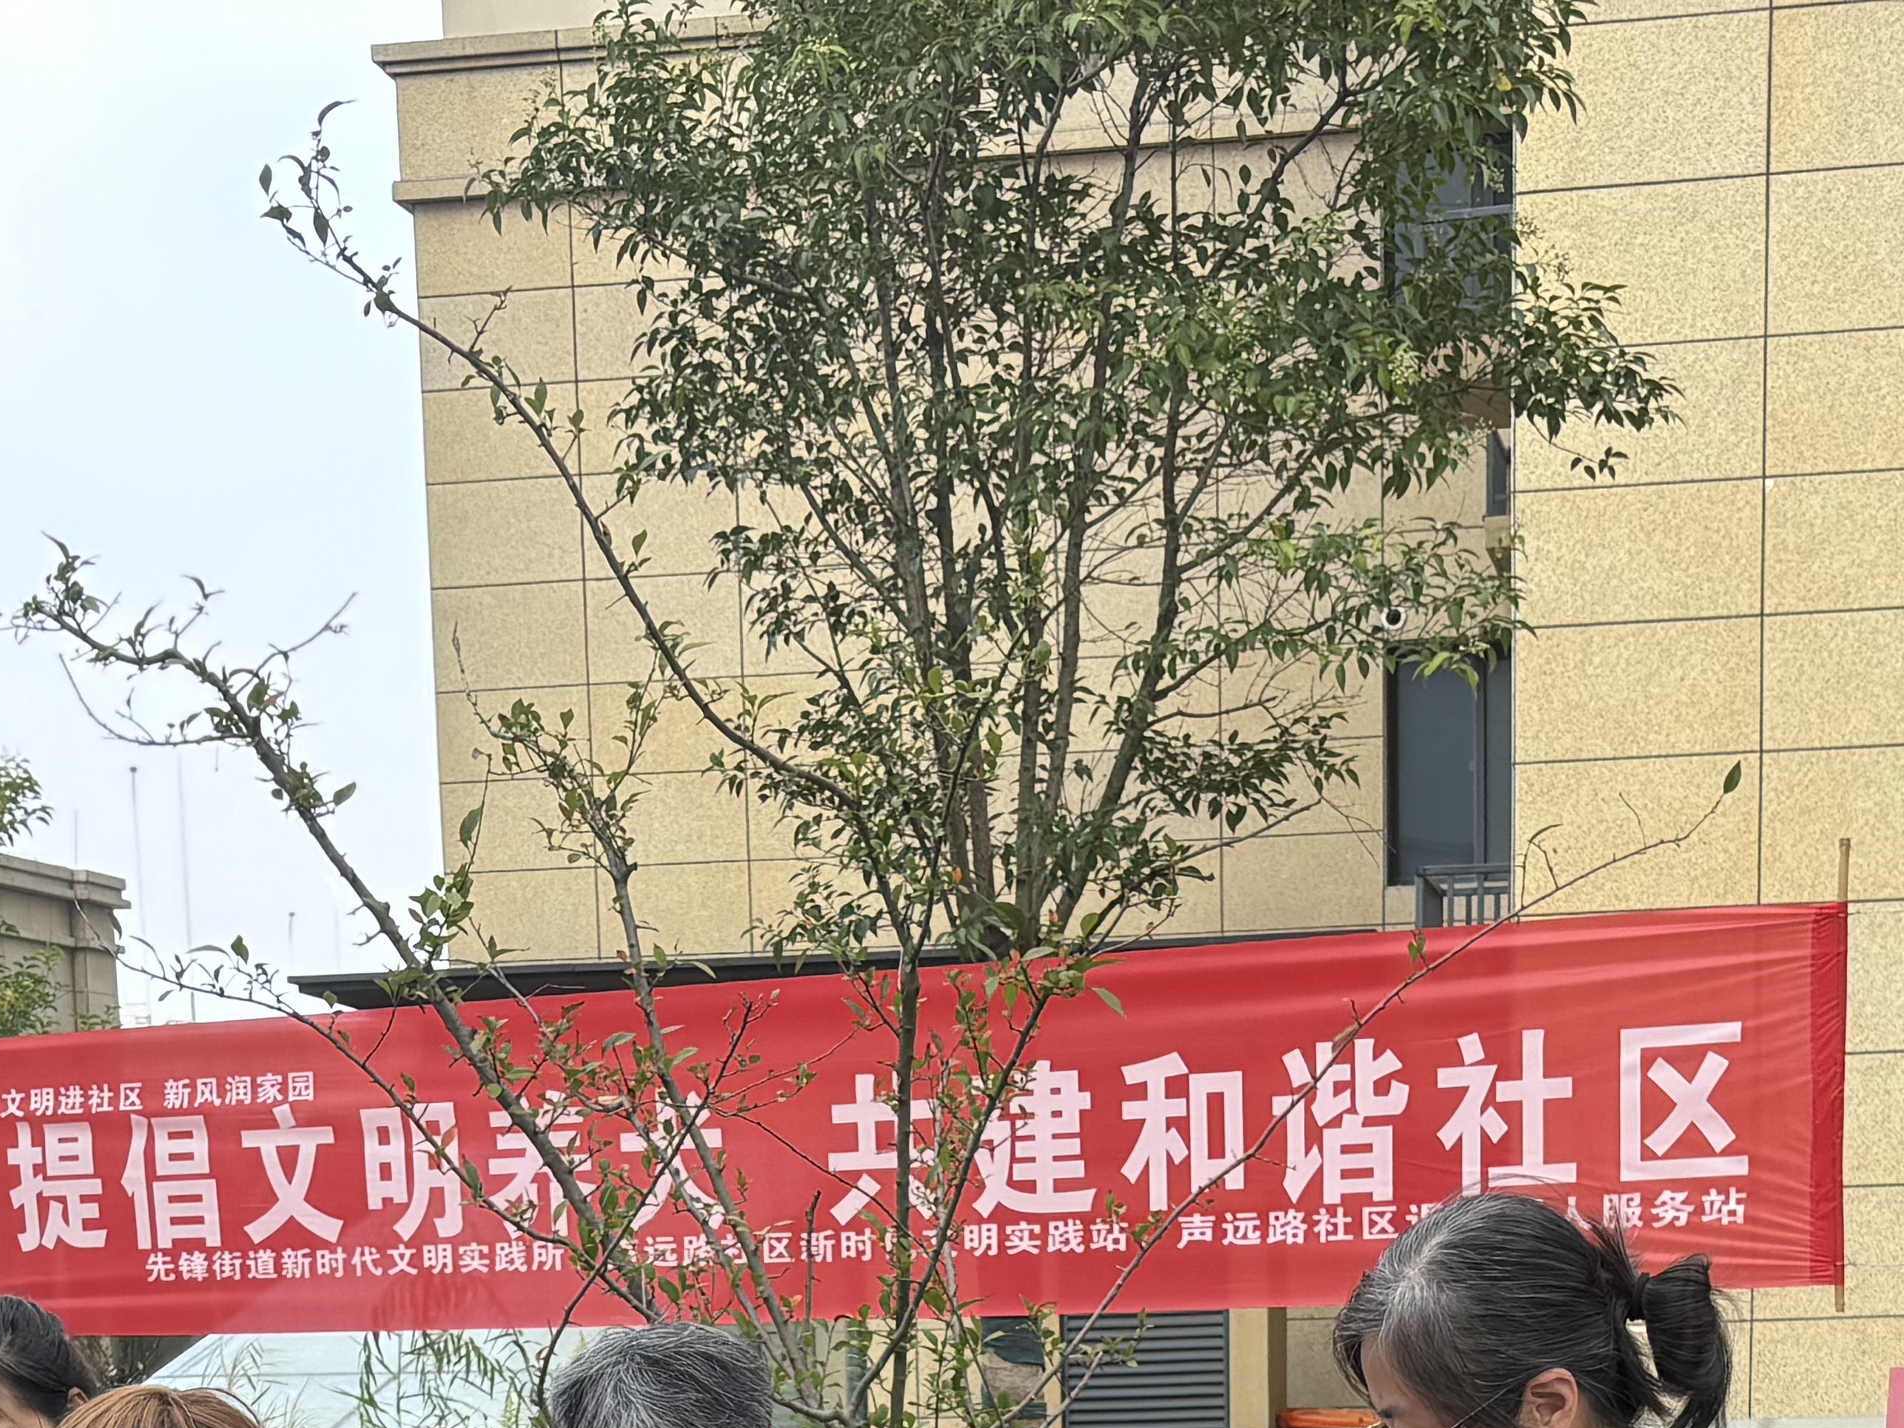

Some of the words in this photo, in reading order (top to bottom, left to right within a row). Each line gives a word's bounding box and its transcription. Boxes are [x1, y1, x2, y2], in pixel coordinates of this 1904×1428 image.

[0, 1081, 144, 1118] 文明进社区
[162, 1070, 315, 1110] 新风润家园
[827, 1020, 1750, 1226] 共建和谐社区
[145, 1239, 564, 1283] 先锋街道新时代文明实践所
